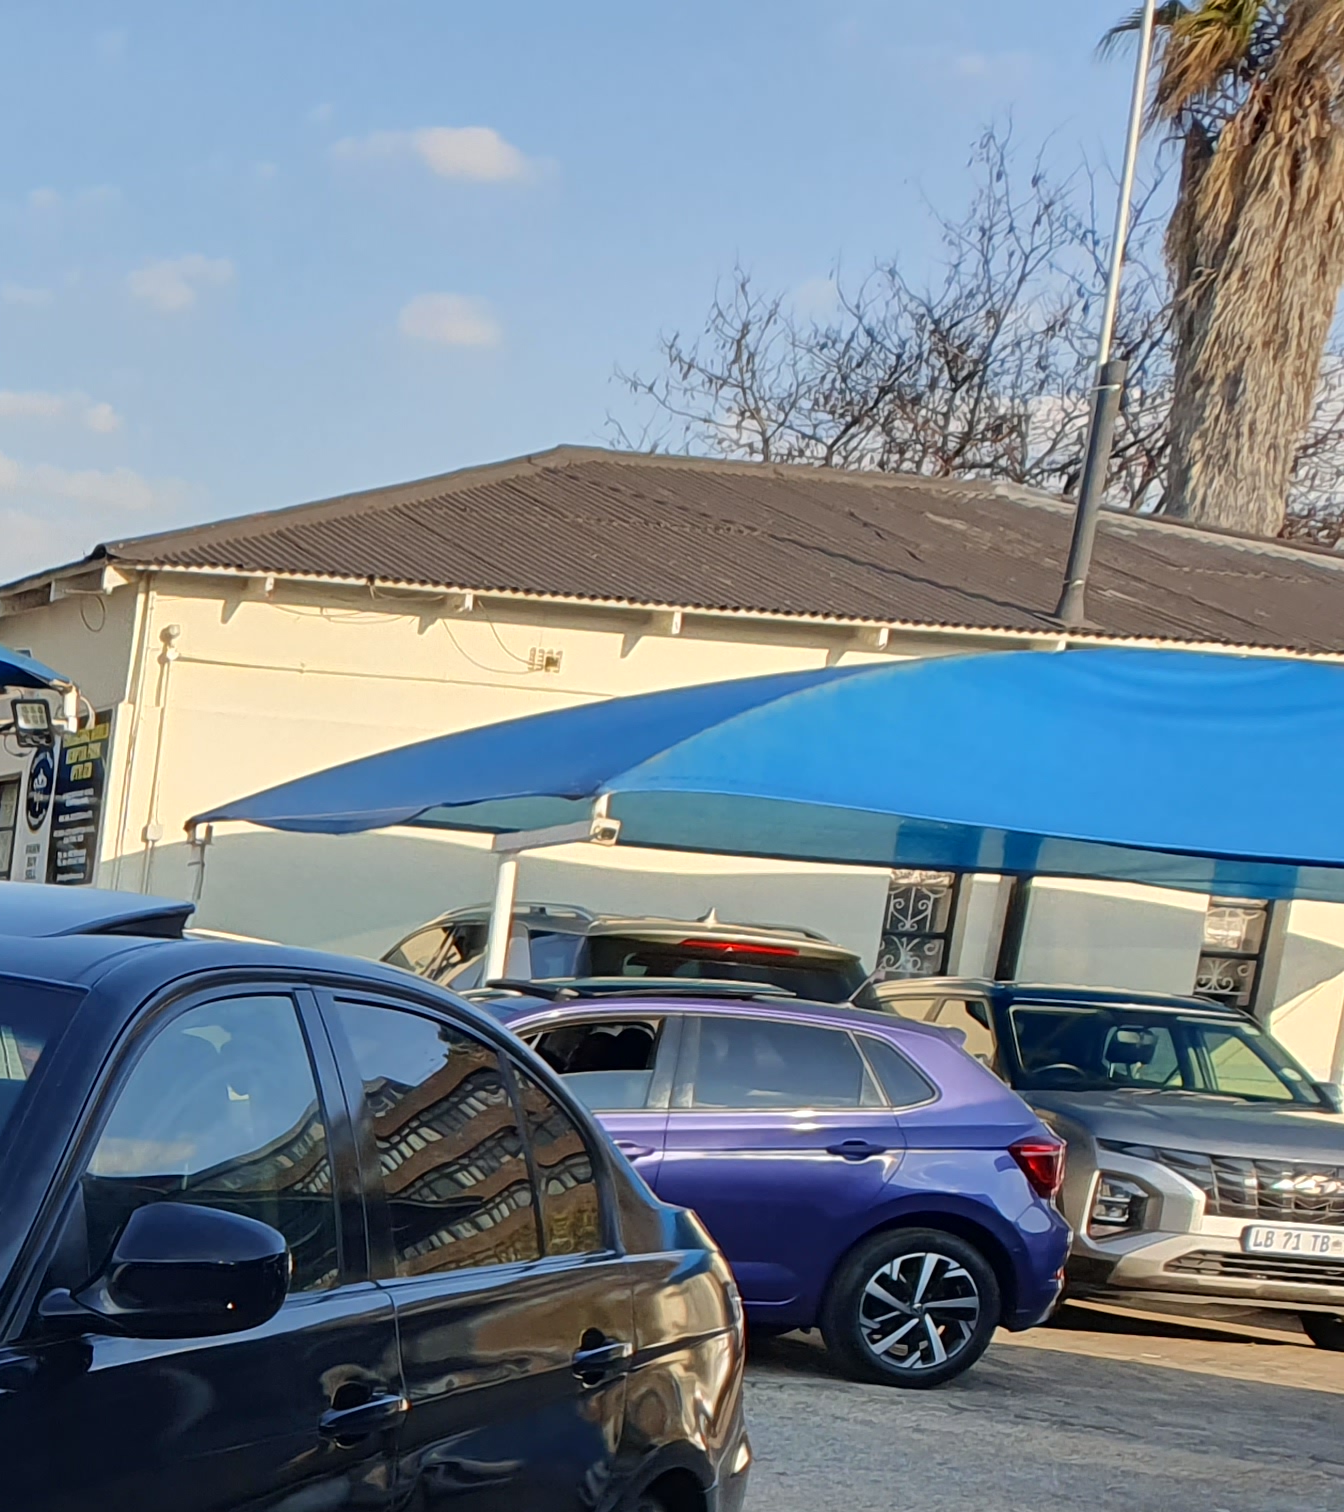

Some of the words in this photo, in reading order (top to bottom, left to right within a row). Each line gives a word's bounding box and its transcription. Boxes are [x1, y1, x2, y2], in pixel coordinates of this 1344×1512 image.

[1253, 1229, 1275, 1248] LB
[1282, 1231, 1301, 1251] 71
[1312, 1234, 1331, 1252] TB
